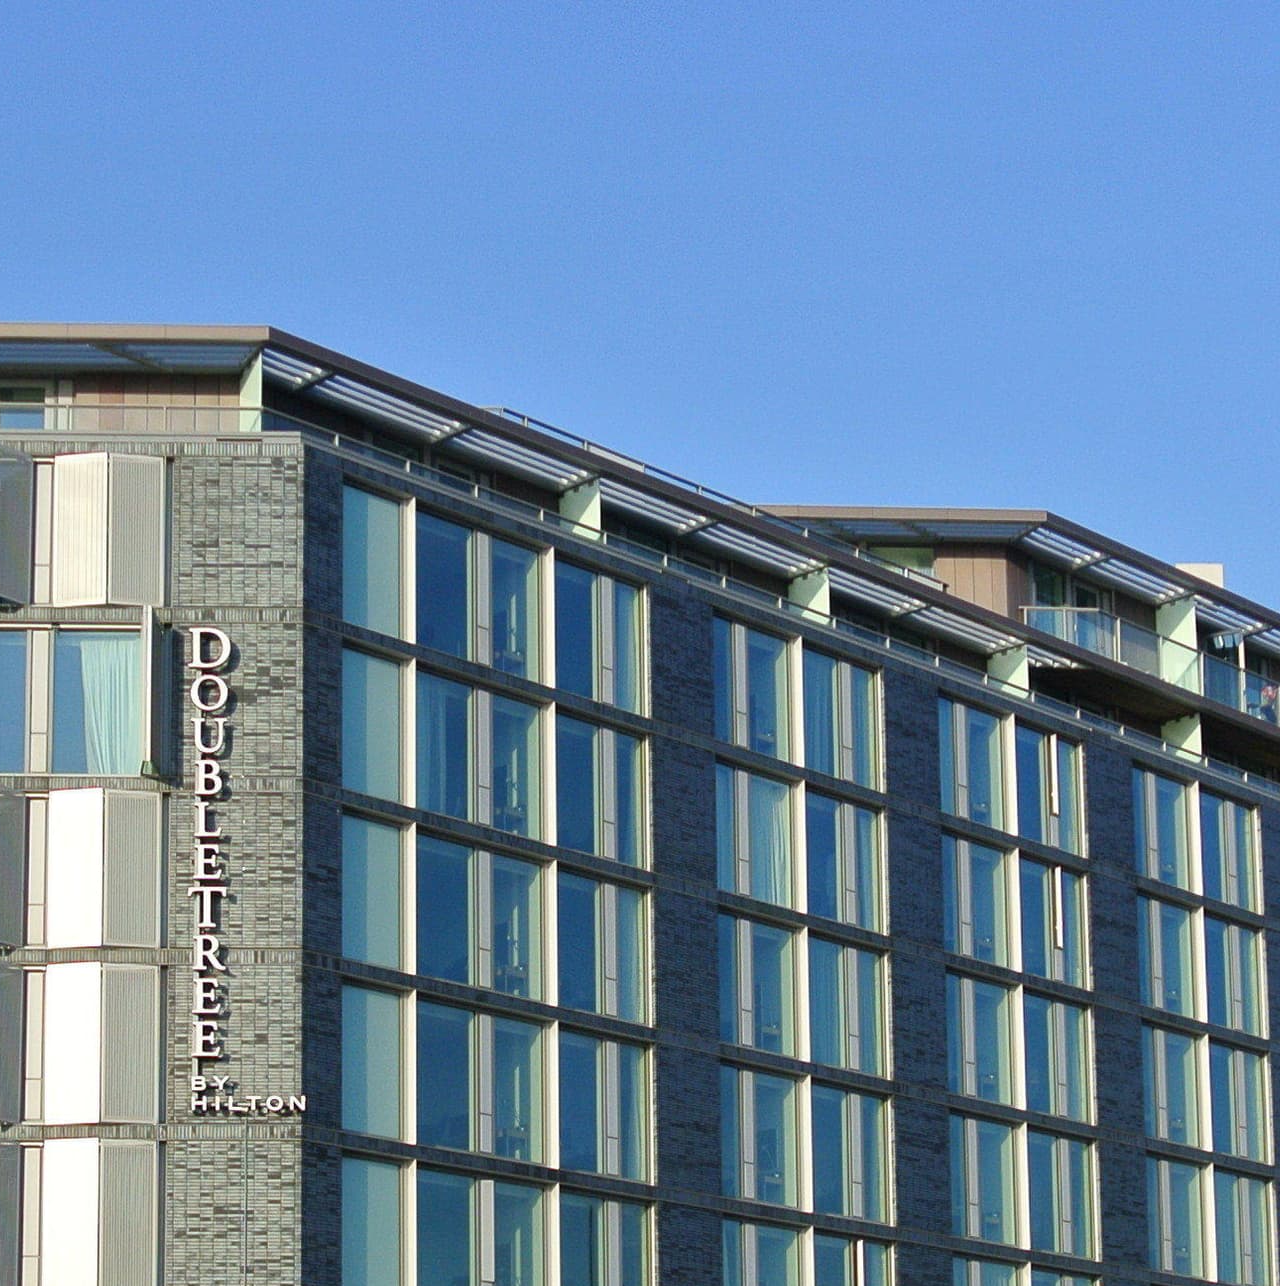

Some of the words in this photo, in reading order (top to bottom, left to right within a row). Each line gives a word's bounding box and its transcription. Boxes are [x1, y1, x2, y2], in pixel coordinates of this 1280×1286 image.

[188, 626, 232, 1060] DOUBLETREE
[191, 1075, 229, 1091] BY
[191, 1095, 307, 1112] HILTON
